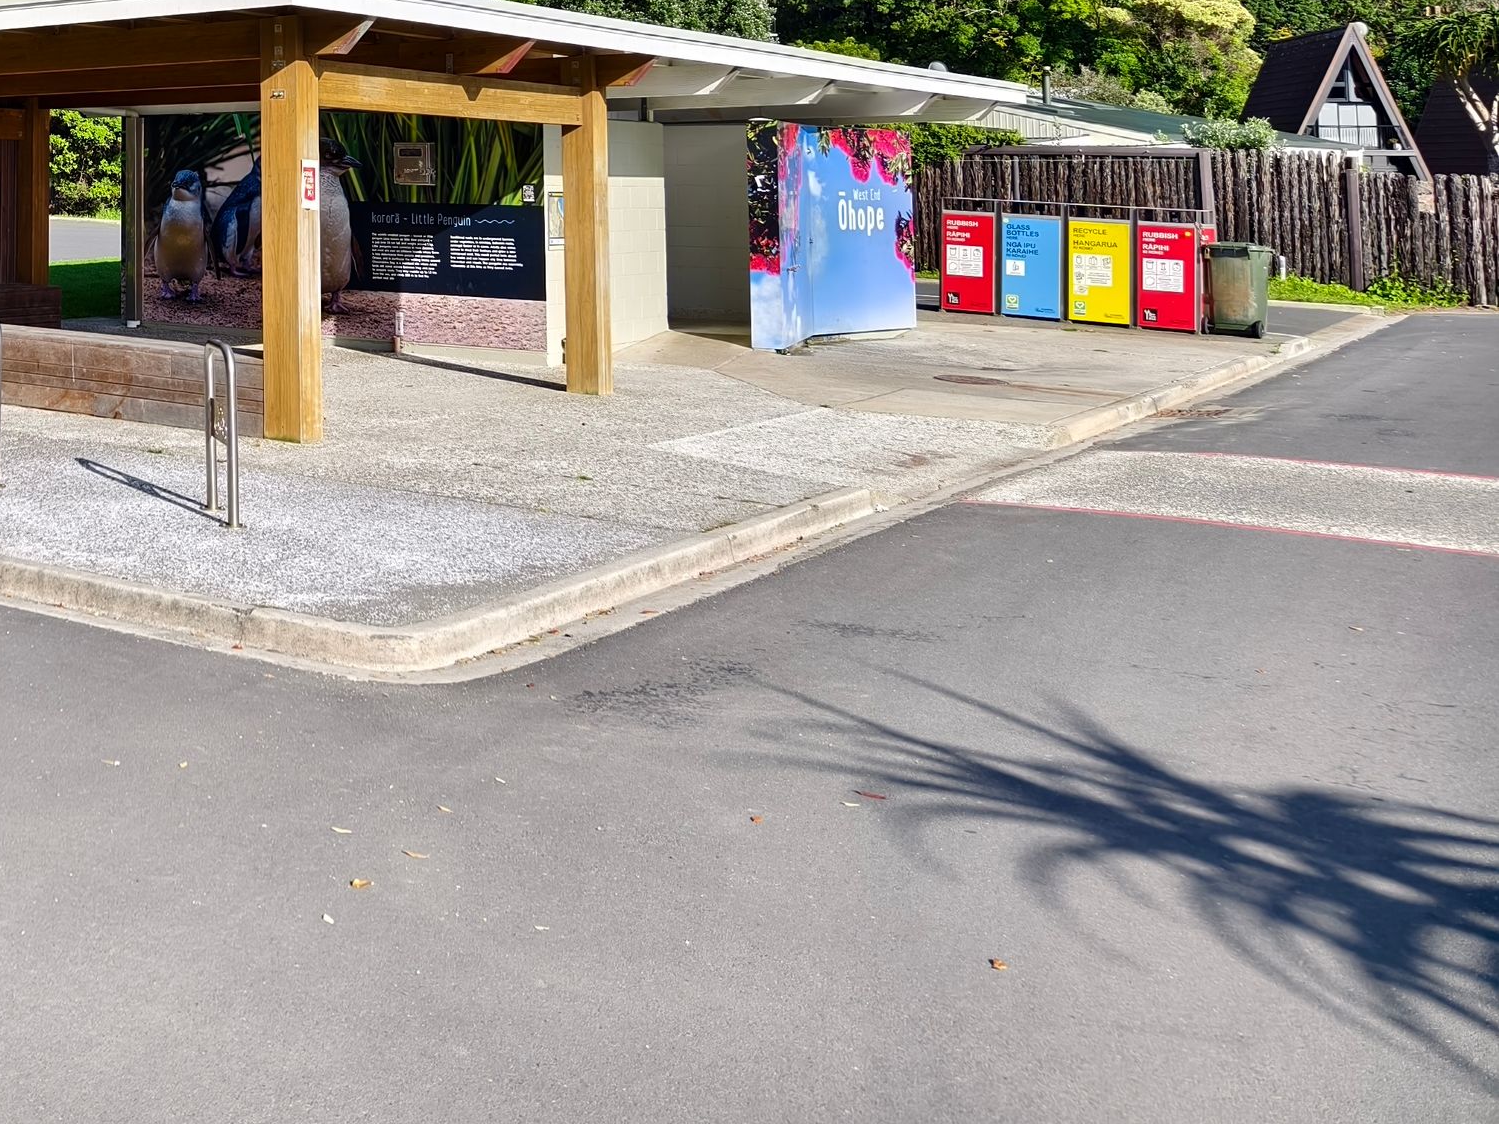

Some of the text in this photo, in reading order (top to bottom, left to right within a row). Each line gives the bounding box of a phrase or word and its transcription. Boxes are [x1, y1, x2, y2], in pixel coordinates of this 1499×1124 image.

[853, 188, 881, 201] West End
[838, 191, 884, 236] Ōhope
[411, 213, 434, 225] Little
[437, 214, 471, 228] Penguin
[946, 219, 979, 228] RUBBISH
[1073, 227, 1107, 235] RECYCLE
[1142, 231, 1179, 240] RUBBISH
[1073, 240, 1118, 248] HANGARUA
[1006, 248, 1039, 256] KARAIHE
